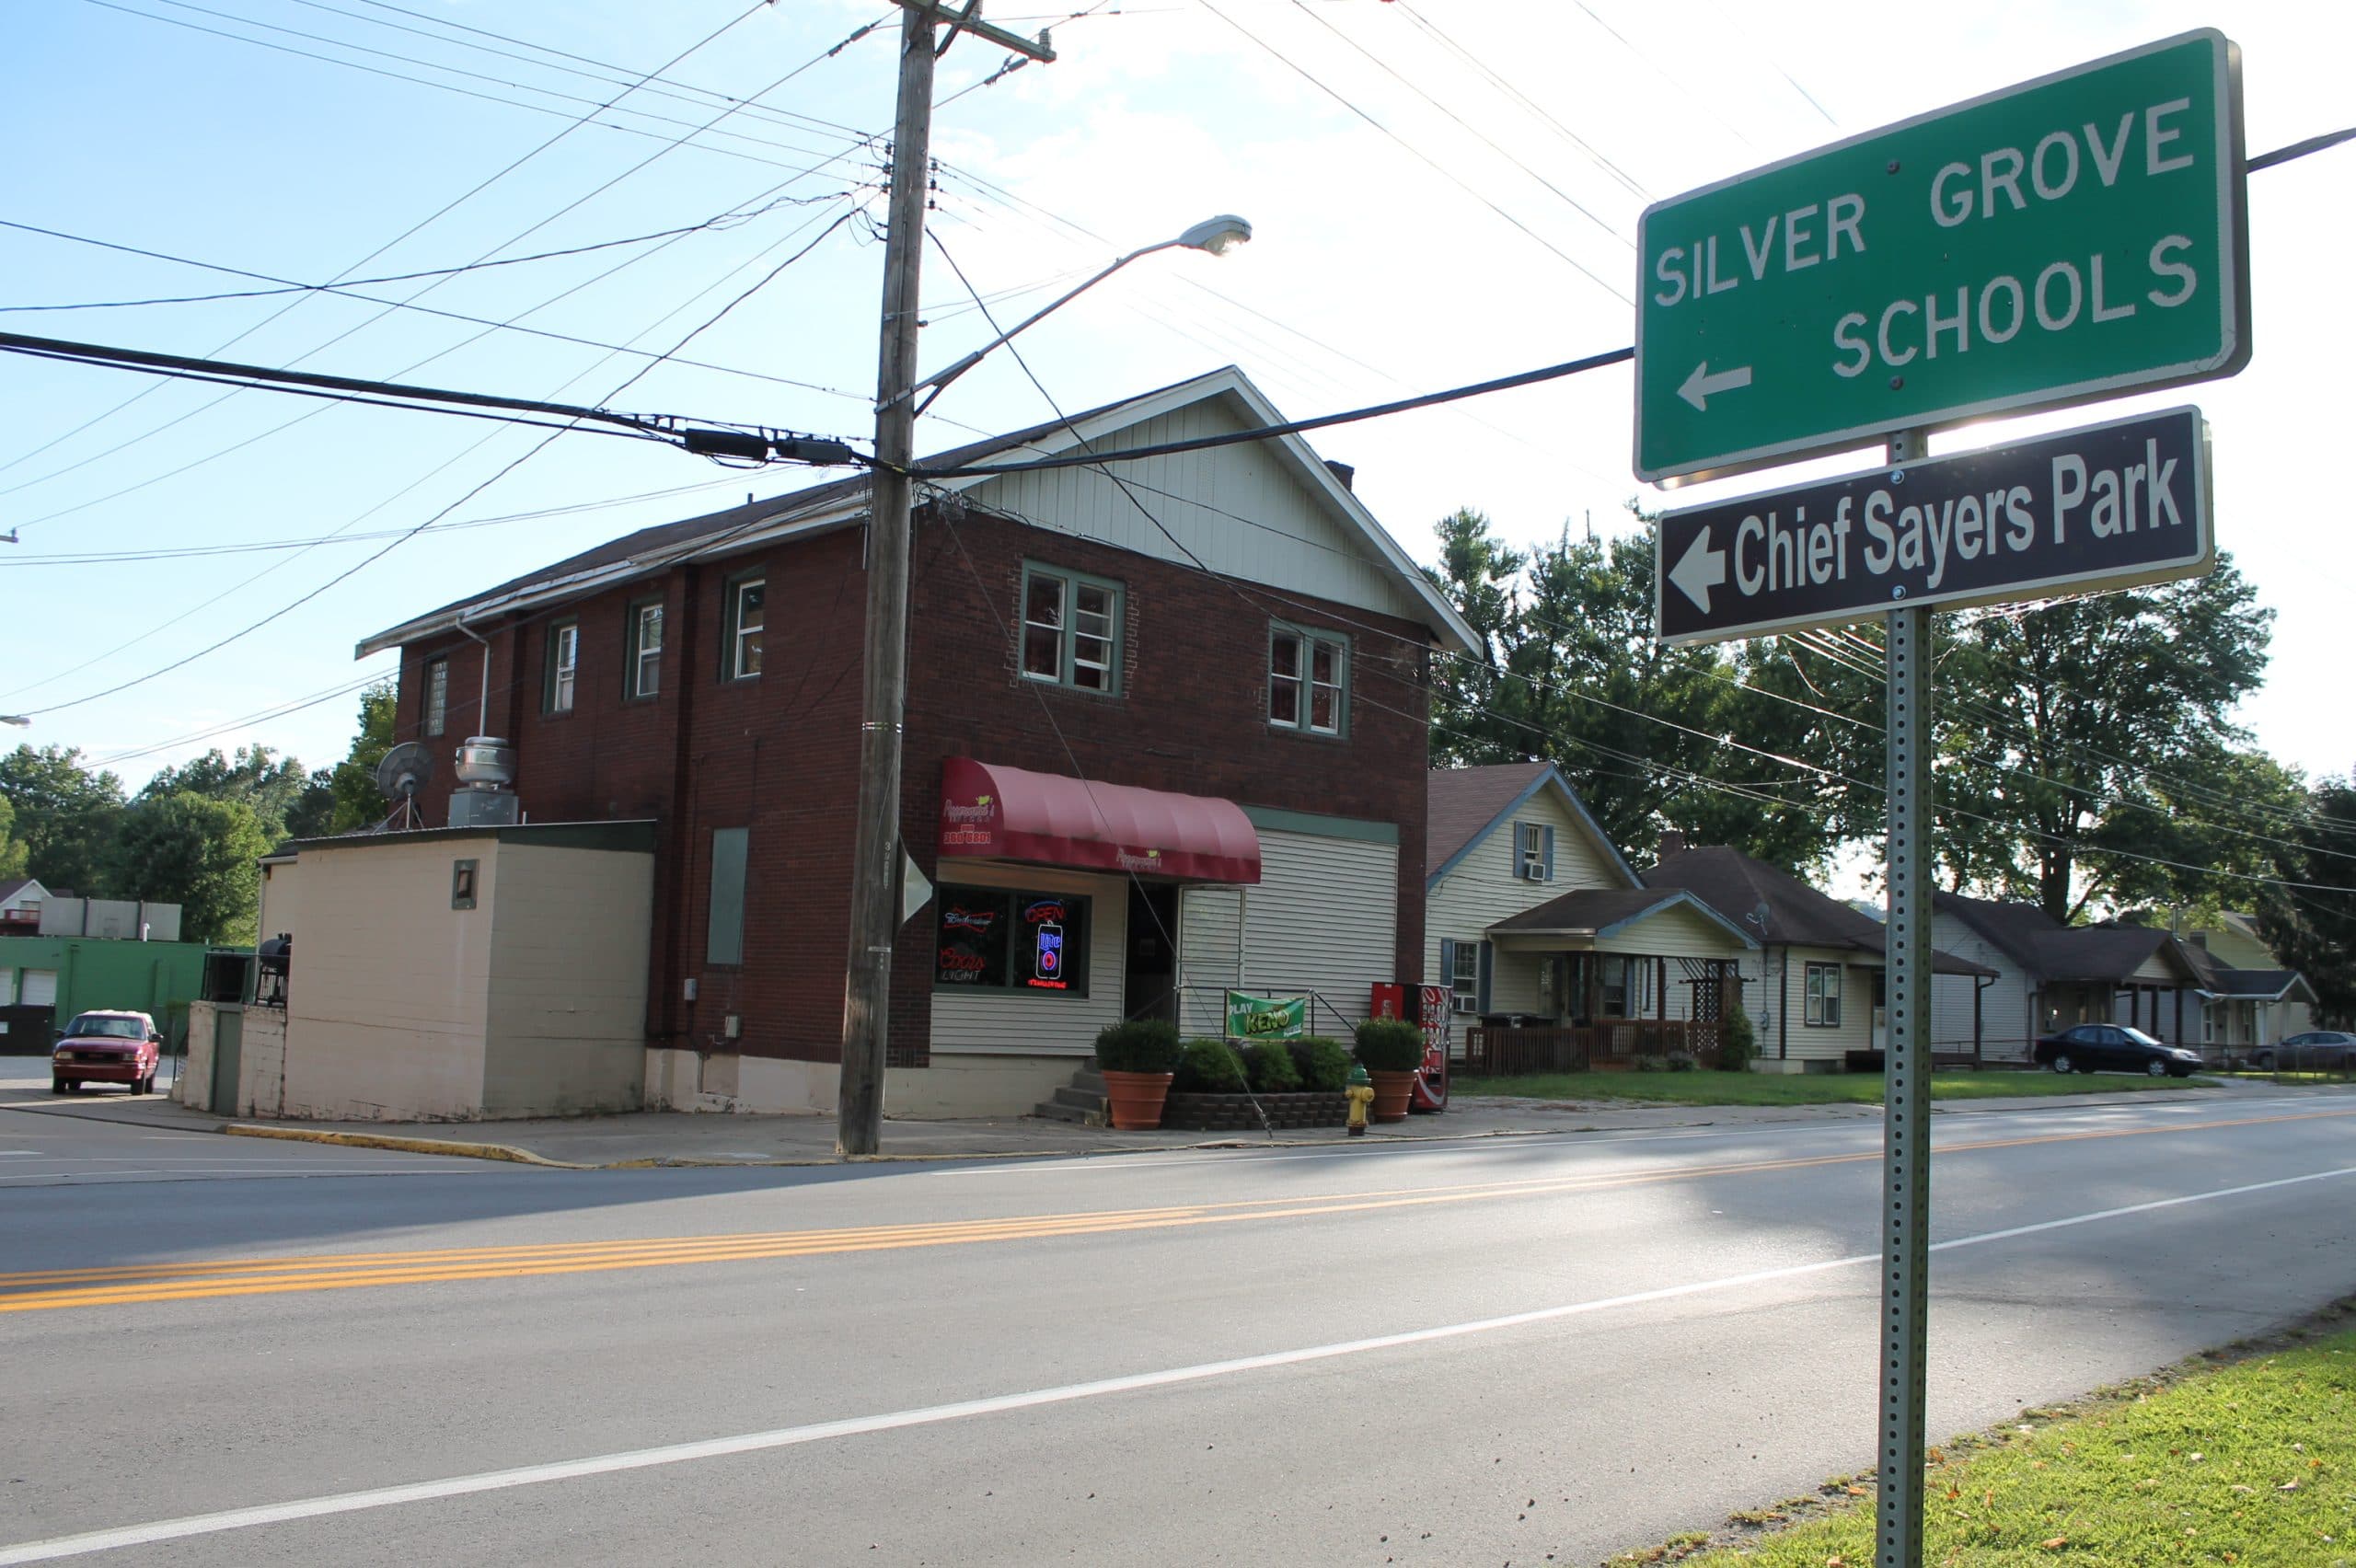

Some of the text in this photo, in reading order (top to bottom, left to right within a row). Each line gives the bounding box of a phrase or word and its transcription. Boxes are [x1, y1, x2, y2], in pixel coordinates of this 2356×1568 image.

[1655, 97, 2194, 306] SILVER GROVE
[1832, 235, 2197, 377] SCHOOLS
[1735, 438, 2181, 596] Chief Sayers Park
[1026, 906, 1065, 922] OPEN
[941, 948, 985, 971] Coors
[941, 969, 981, 981] LIGHT
[1229, 1002, 1253, 1016] PLAY
[1245, 1009, 1291, 1034] KENO
